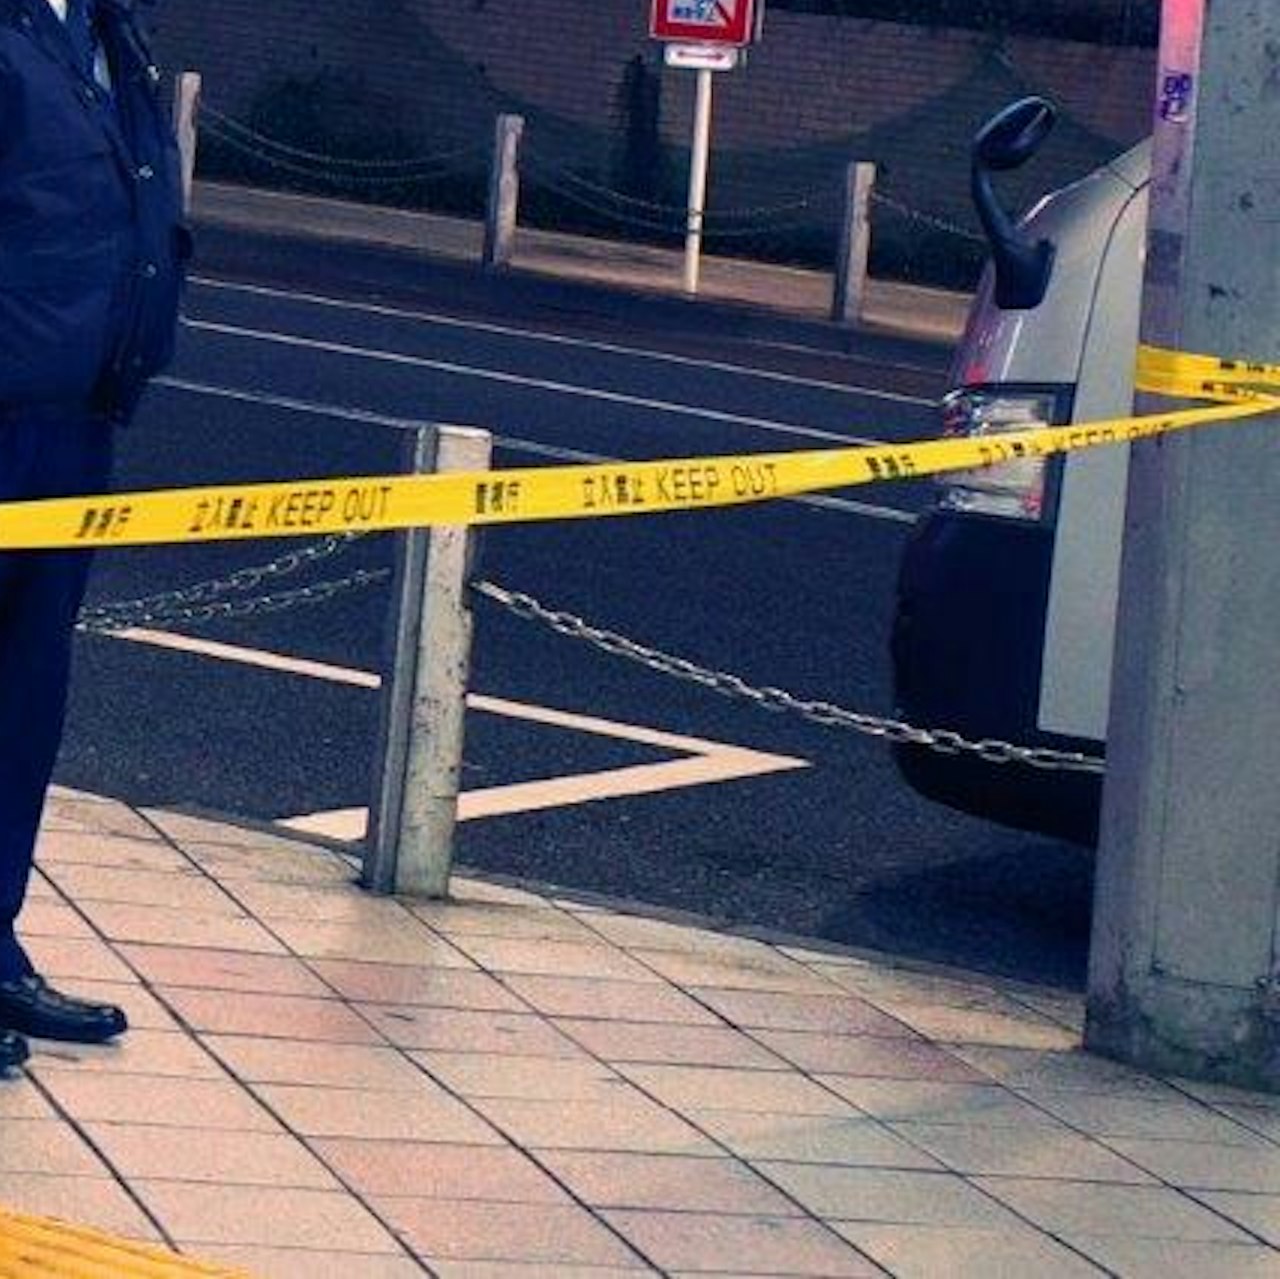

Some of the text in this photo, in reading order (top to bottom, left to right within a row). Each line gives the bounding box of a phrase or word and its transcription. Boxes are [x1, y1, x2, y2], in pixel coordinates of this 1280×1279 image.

[656, 467, 720, 501] KEEP
[730, 463, 777, 496] OUT
[264, 488, 336, 528] KEEP
[341, 486, 393, 523] OUT
